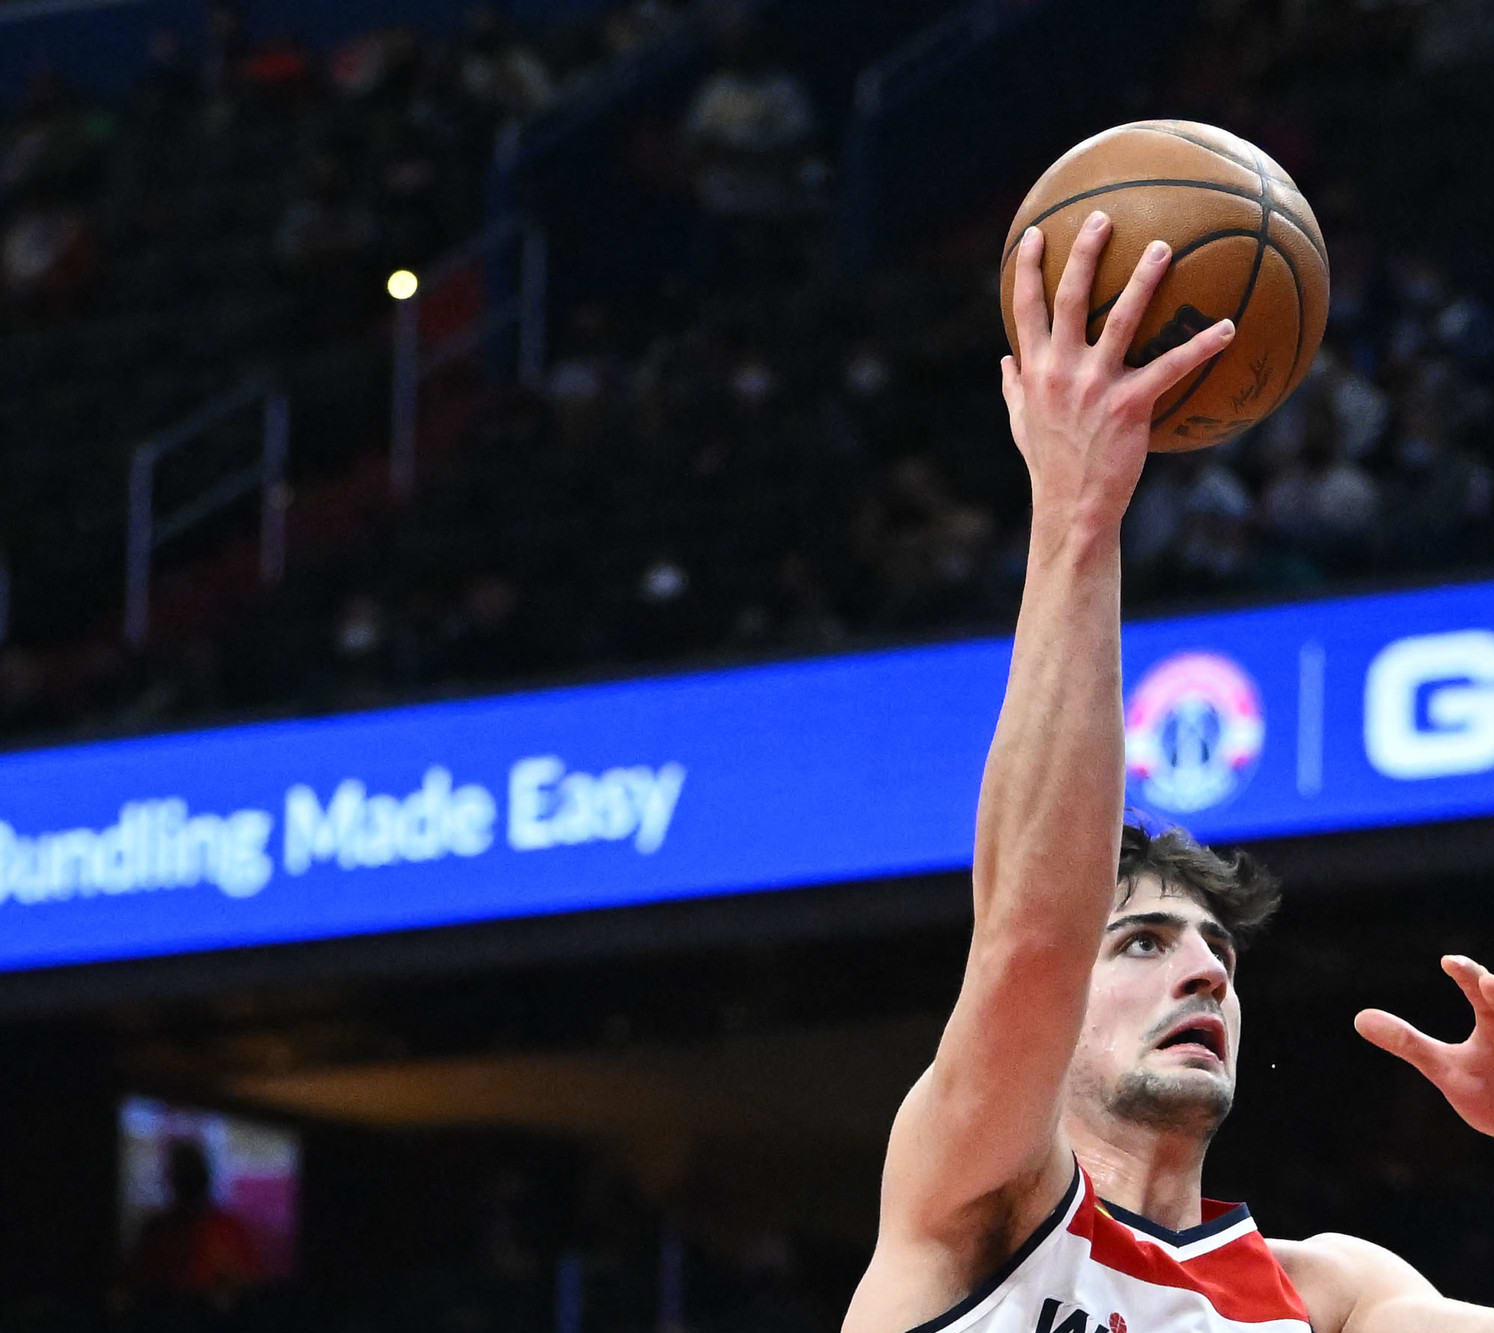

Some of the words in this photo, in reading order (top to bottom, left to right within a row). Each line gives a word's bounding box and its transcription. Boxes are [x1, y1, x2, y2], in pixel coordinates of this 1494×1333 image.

[0, 797, 274, 906] undling
[284, 765, 498, 876] Made
[508, 755, 687, 855] Easy
